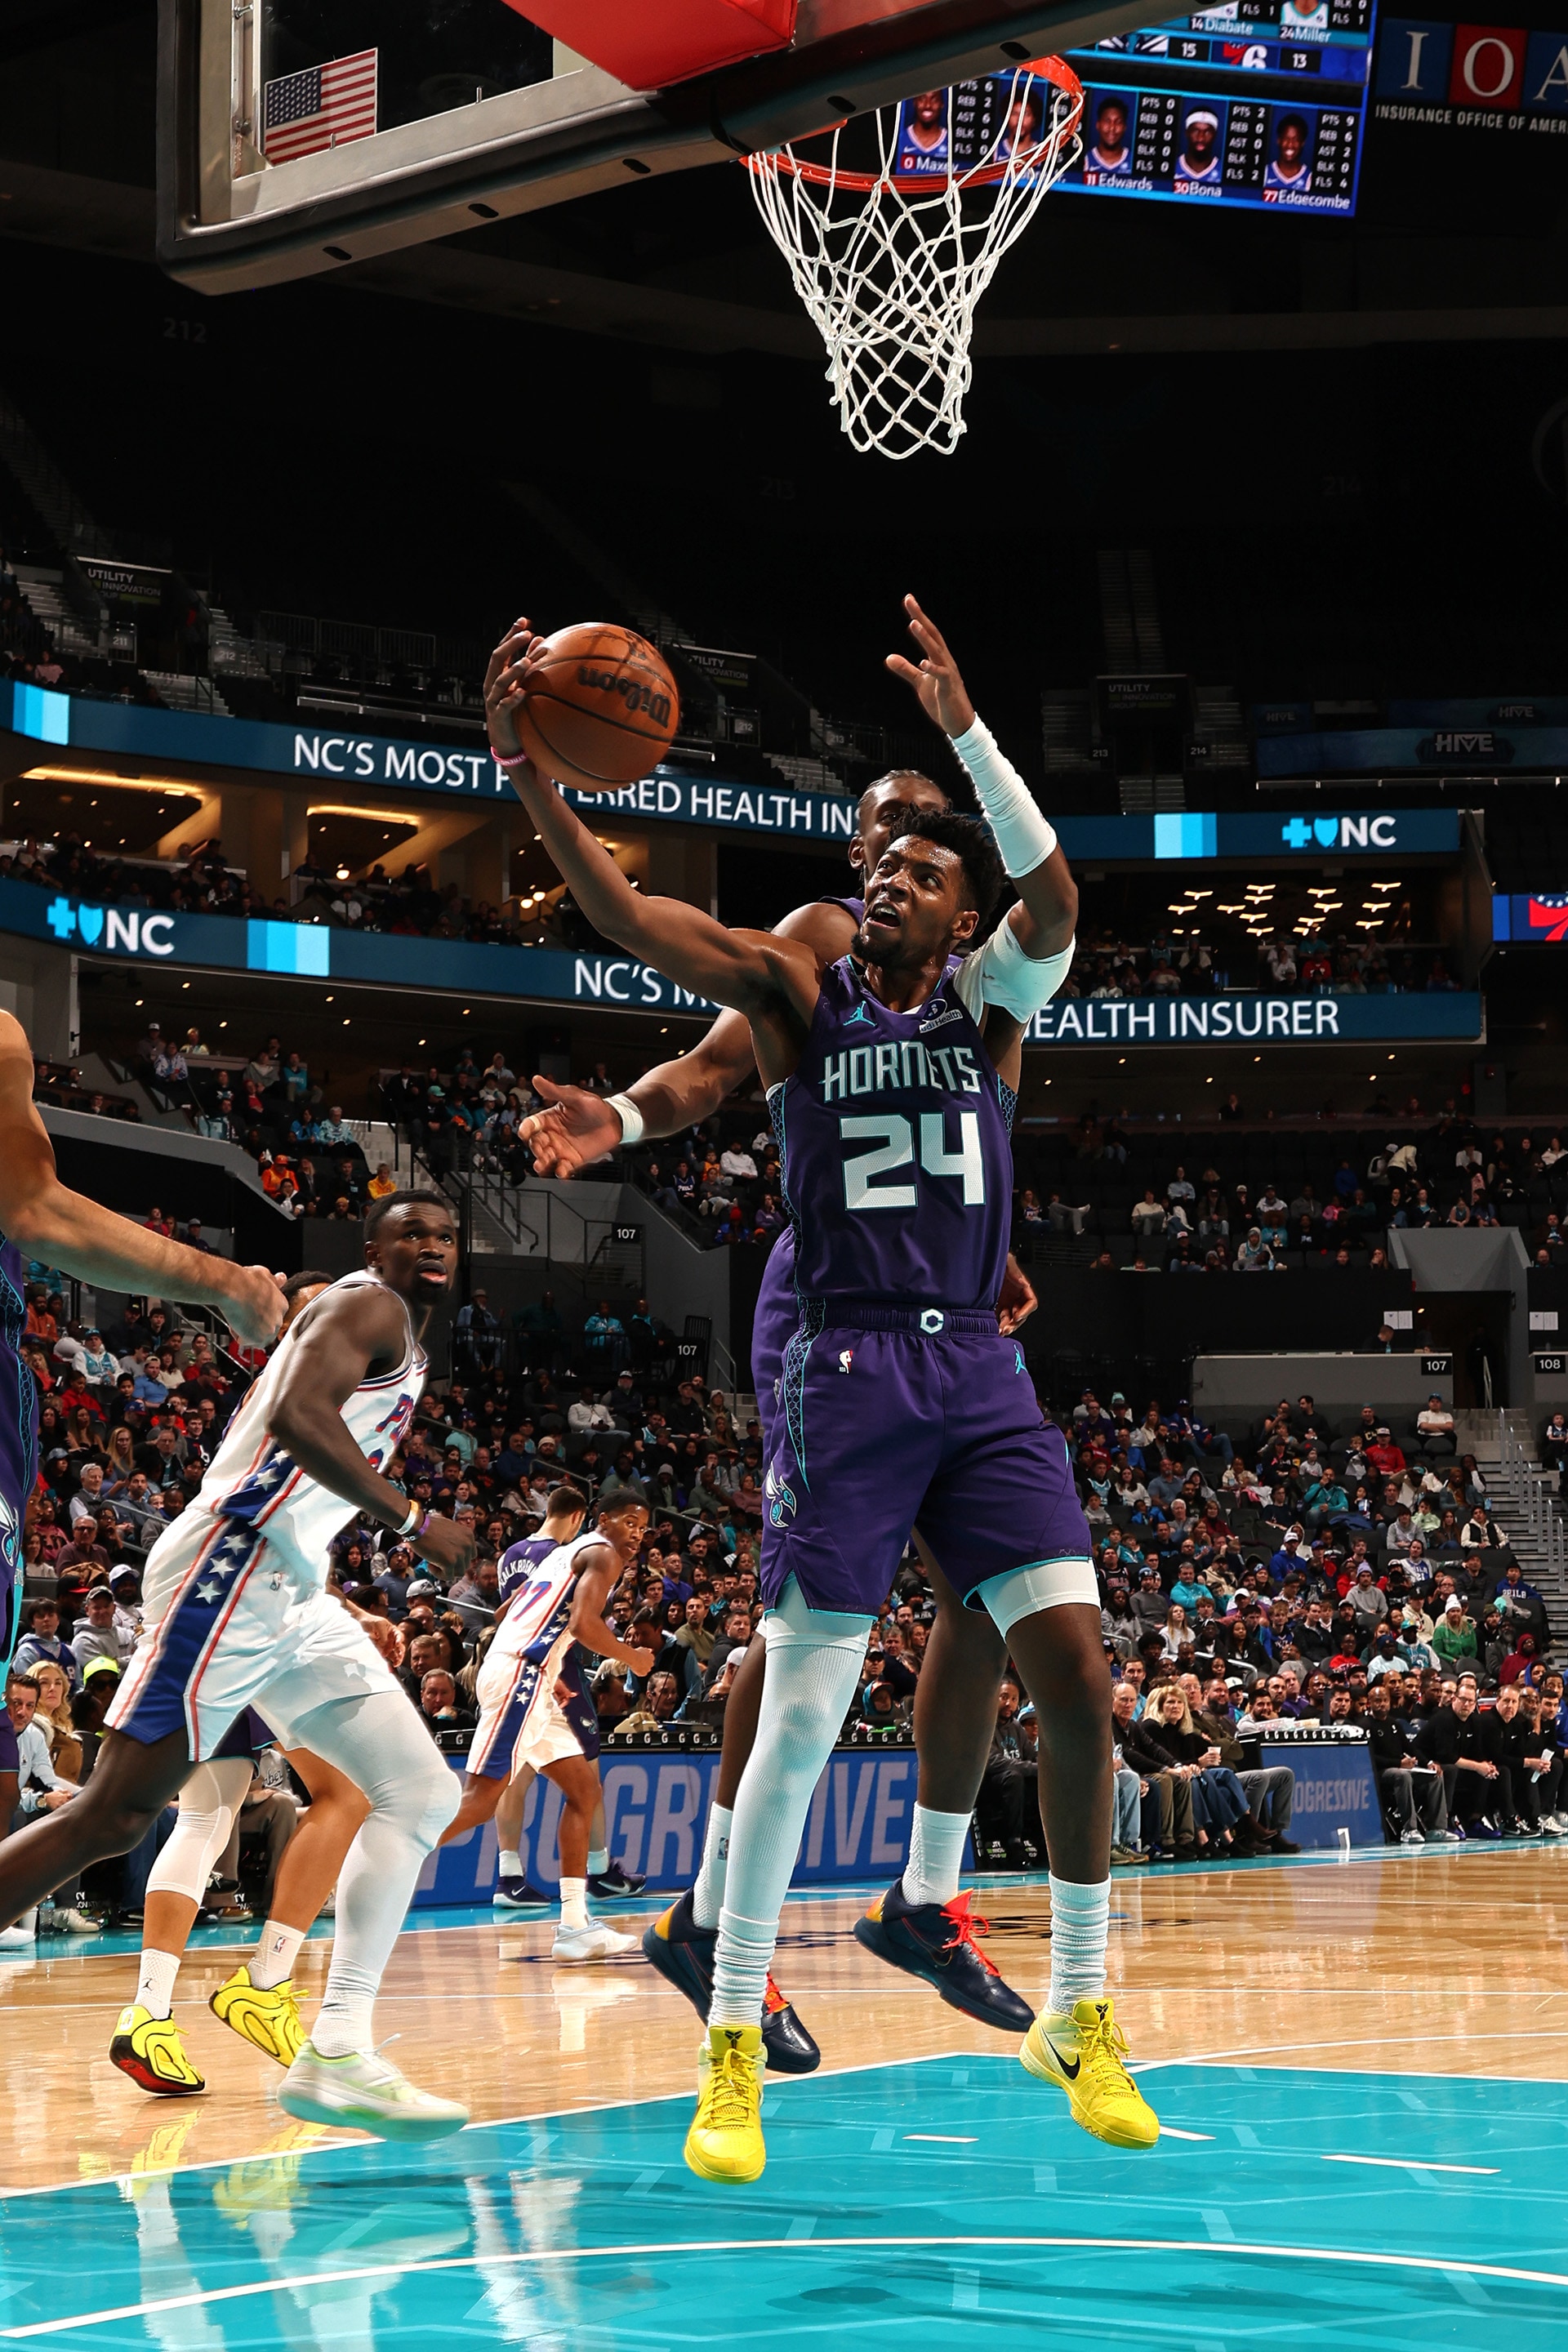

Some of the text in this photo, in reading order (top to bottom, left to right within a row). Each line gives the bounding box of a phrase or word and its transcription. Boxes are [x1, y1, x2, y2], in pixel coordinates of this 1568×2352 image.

[1205, 20, 1254, 36] Diabate
[1294, 27, 1331, 43] Miller
[1182, 42, 1196, 57] 15
[1292, 53, 1307, 68] 13
[984, 81, 993, 91] 6
[957, 96, 992, 108] REB 2
[1142, 97, 1175, 109] PTS 0
[956, 112, 991, 124] AST 6
[1232, 105, 1266, 118] PTS 2
[1375, 105, 1451, 124] INSURANCE
[1457, 111, 1503, 129] OFFICE
[1508, 116, 1526, 131] OF
[1139, 113, 1174, 125] REB 0
[1321, 114, 1355, 127] PTS 9
[955, 127, 990, 139] BLK 0
[1138, 128, 1172, 140] AST 0
[1230, 122, 1264, 134] REB 0
[1319, 130, 1352, 142] REB 6
[955, 143, 972, 154] FLS
[1229, 137, 1263, 149] AST 0
[1137, 144, 1170, 157] BLK 0
[1318, 145, 1351, 158] AST 2
[904, 158, 914, 169] 0
[1227, 153, 1259, 164] BLK 1
[1136, 159, 1169, 172] FLS 0
[1316, 161, 1349, 173] BLK 0
[1226, 169, 1259, 180] FLS 2
[1086, 174, 1153, 191] 11 Edwards
[1315, 176, 1348, 188] FLS 4
[1174, 181, 1223, 198] 30 Bona
[1263, 189, 1278, 202] 77
[163, 317, 207, 344] 212
[88, 568, 134, 583] UTILITY
[102, 581, 162, 597] INNOVATION
[113, 636, 127, 646] 211
[219, 651, 235, 661] 212
[692, 655, 725, 668] TILITY
[1108, 684, 1150, 693] UTILITY
[577, 665, 670, 728] Wilson
[1267, 711, 1296, 722] HIVE
[1499, 706, 1535, 718] HIVE
[1435, 733, 1494, 752] HIVE
[1093, 749, 1108, 758] 213
[1190, 746, 1206, 756] 214
[385, 745, 487, 789] MOST
[691, 785, 812, 831] HEALTH
[1342, 816, 1396, 847] NC
[107, 909, 175, 956] NC
[935, 1009, 962, 1027] Health
[1026, 1000, 1339, 1039] EALTH INSURER
[818, 1040, 982, 1103] HORNETS
[839, 1110, 987, 1211] 24
[617, 1227, 635, 1240] 107
[678, 1344, 697, 1356] 107
[1426, 1361, 1446, 1372] 107
[1539, 1358, 1561, 1370] 108
[456, 1734, 463, 1745] G
[608, 1733, 614, 1744] G
[626, 1733, 633, 1744] G
[644, 1732, 651, 1744] G
[662, 1732, 668, 1744] G
[679, 1732, 685, 1744] G
[693, 1732, 700, 1744] G
[851, 1732, 858, 1742] G
[866, 1732, 873, 1743] G
[882, 1732, 889, 1742] G
[897, 1732, 903, 1742] G
[1292, 1779, 1370, 1814] OGRESSIVE
